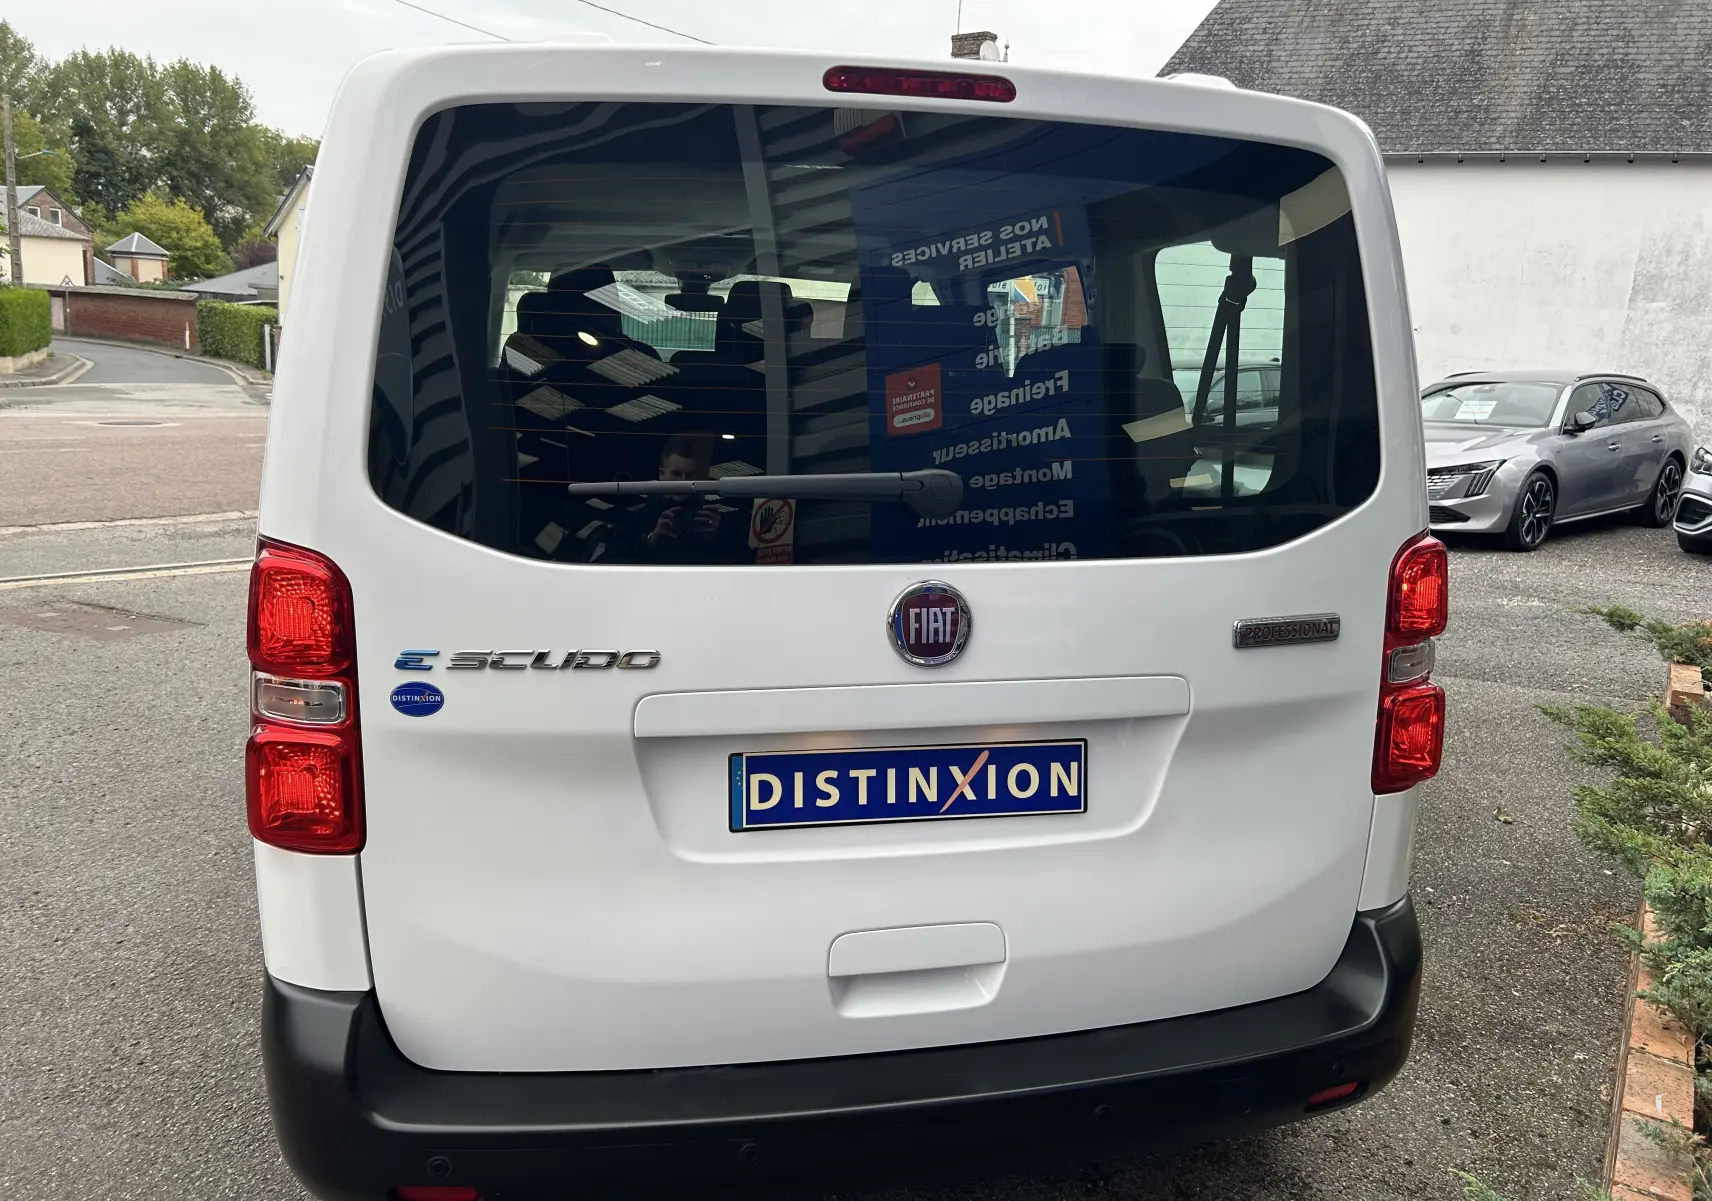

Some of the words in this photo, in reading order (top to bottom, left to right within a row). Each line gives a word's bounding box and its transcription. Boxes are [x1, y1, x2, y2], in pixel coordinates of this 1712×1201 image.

[909, 606, 955, 644] FIAT
[1244, 621, 1335, 640] PROFESSIONAL
[445, 649, 661, 671] SCUDO
[392, 692, 441, 703] DISTINXION
[749, 750, 1079, 813] DISTINXION
